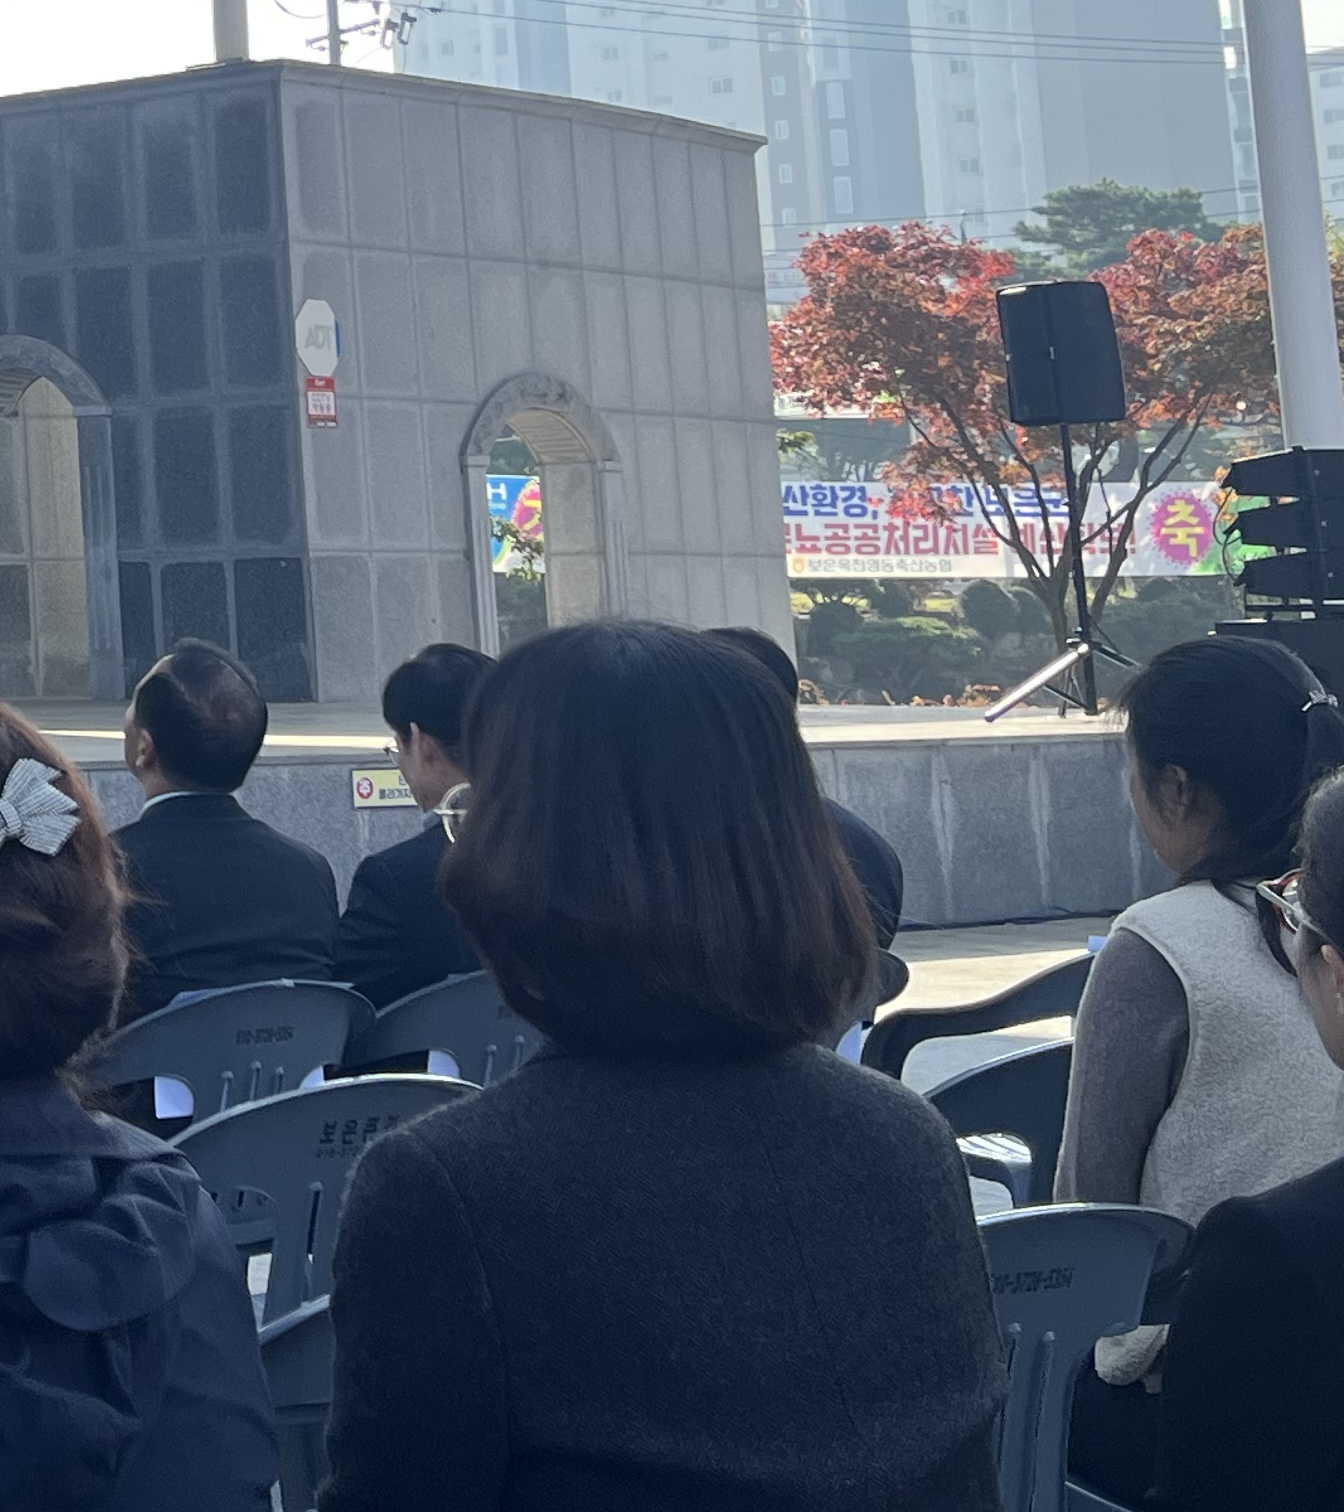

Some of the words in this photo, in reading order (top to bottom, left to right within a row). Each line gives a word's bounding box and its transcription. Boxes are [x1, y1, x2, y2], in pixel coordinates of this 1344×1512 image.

[304, 324, 333, 350] ADT
[1159, 499, 1201, 558] 축
[808, 557, 952, 573] 보은옥천영동축산농협
